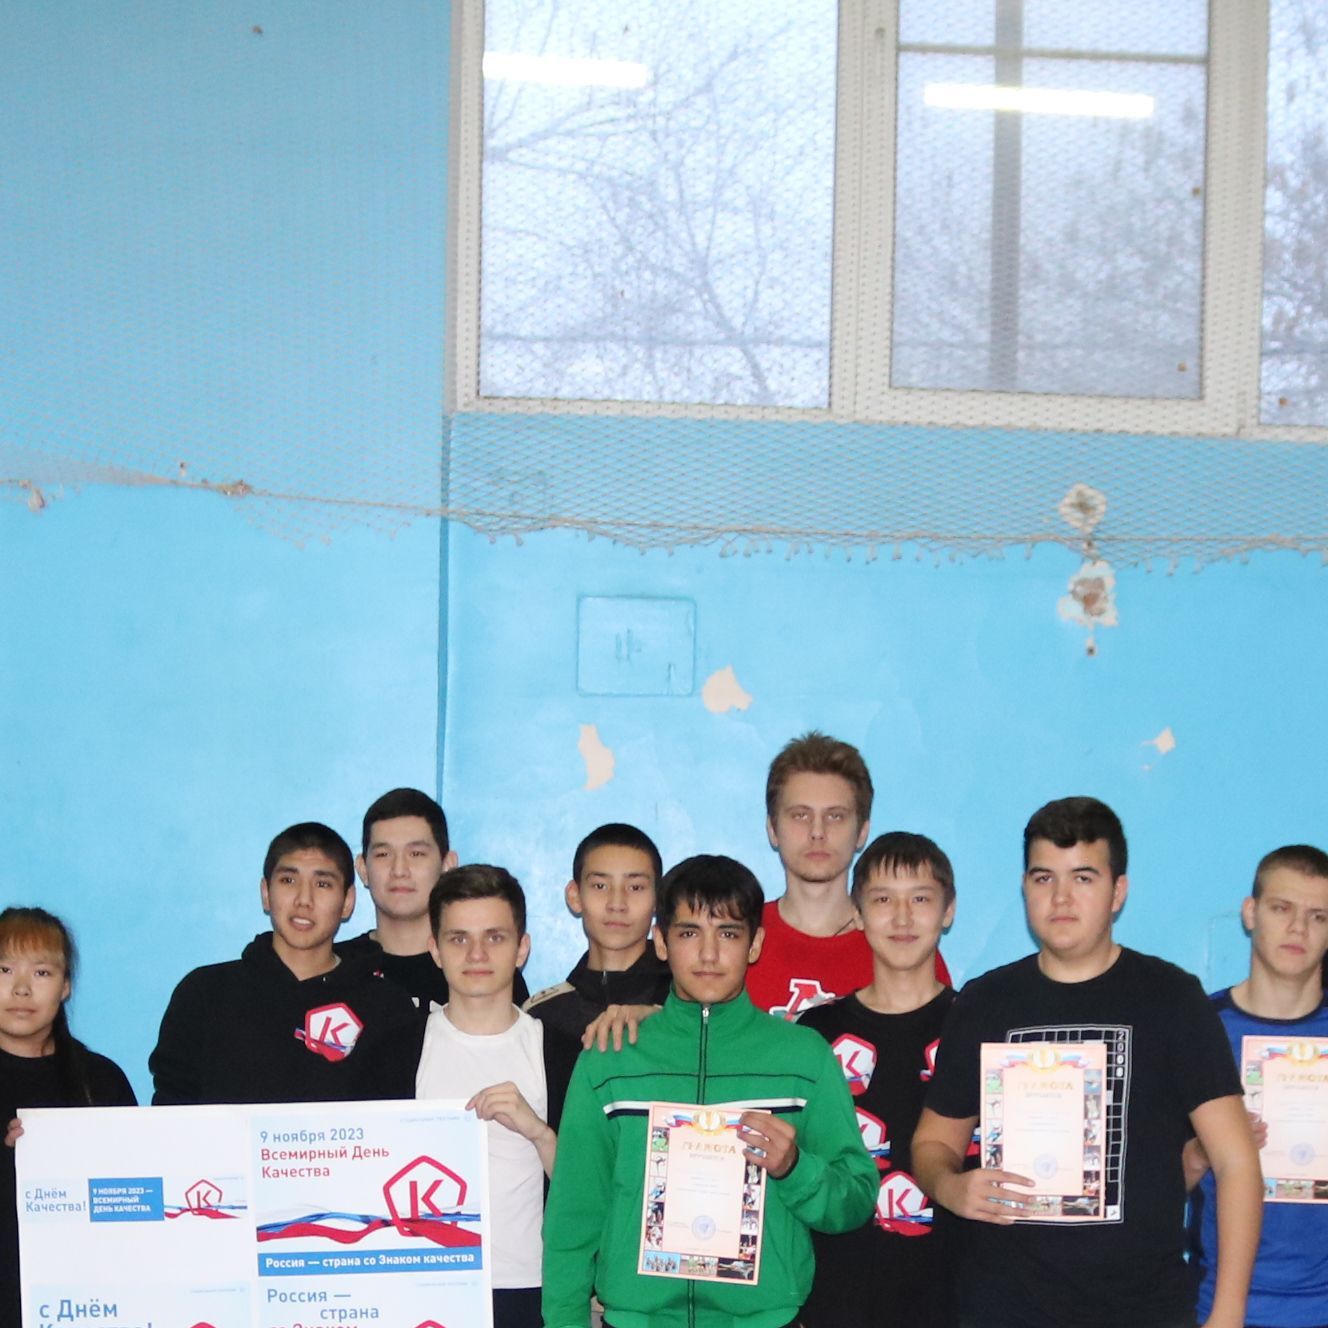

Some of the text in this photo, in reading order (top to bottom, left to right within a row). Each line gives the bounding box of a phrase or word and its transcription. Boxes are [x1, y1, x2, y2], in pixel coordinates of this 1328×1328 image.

[260, 1128, 364, 1144] 9 ноября 2023
[261, 1145, 389, 1162] Всемирный День
[262, 1166, 330, 1178] Качества
[25, 1188, 67, 1201] с Днём
[25, 1201, 86, 1213] Качества!
[266, 1257, 305, 1268] Россия
[323, 1257, 361, 1269] страна
[364, 1256, 376, 1266] со
[379, 1253, 421, 1265] Знаком
[423, 1254, 474, 1264] качества
[267, 1288, 328, 1303] Россия
[39, 1299, 118, 1322] с Днём
[320, 1307, 379, 1323] страна
